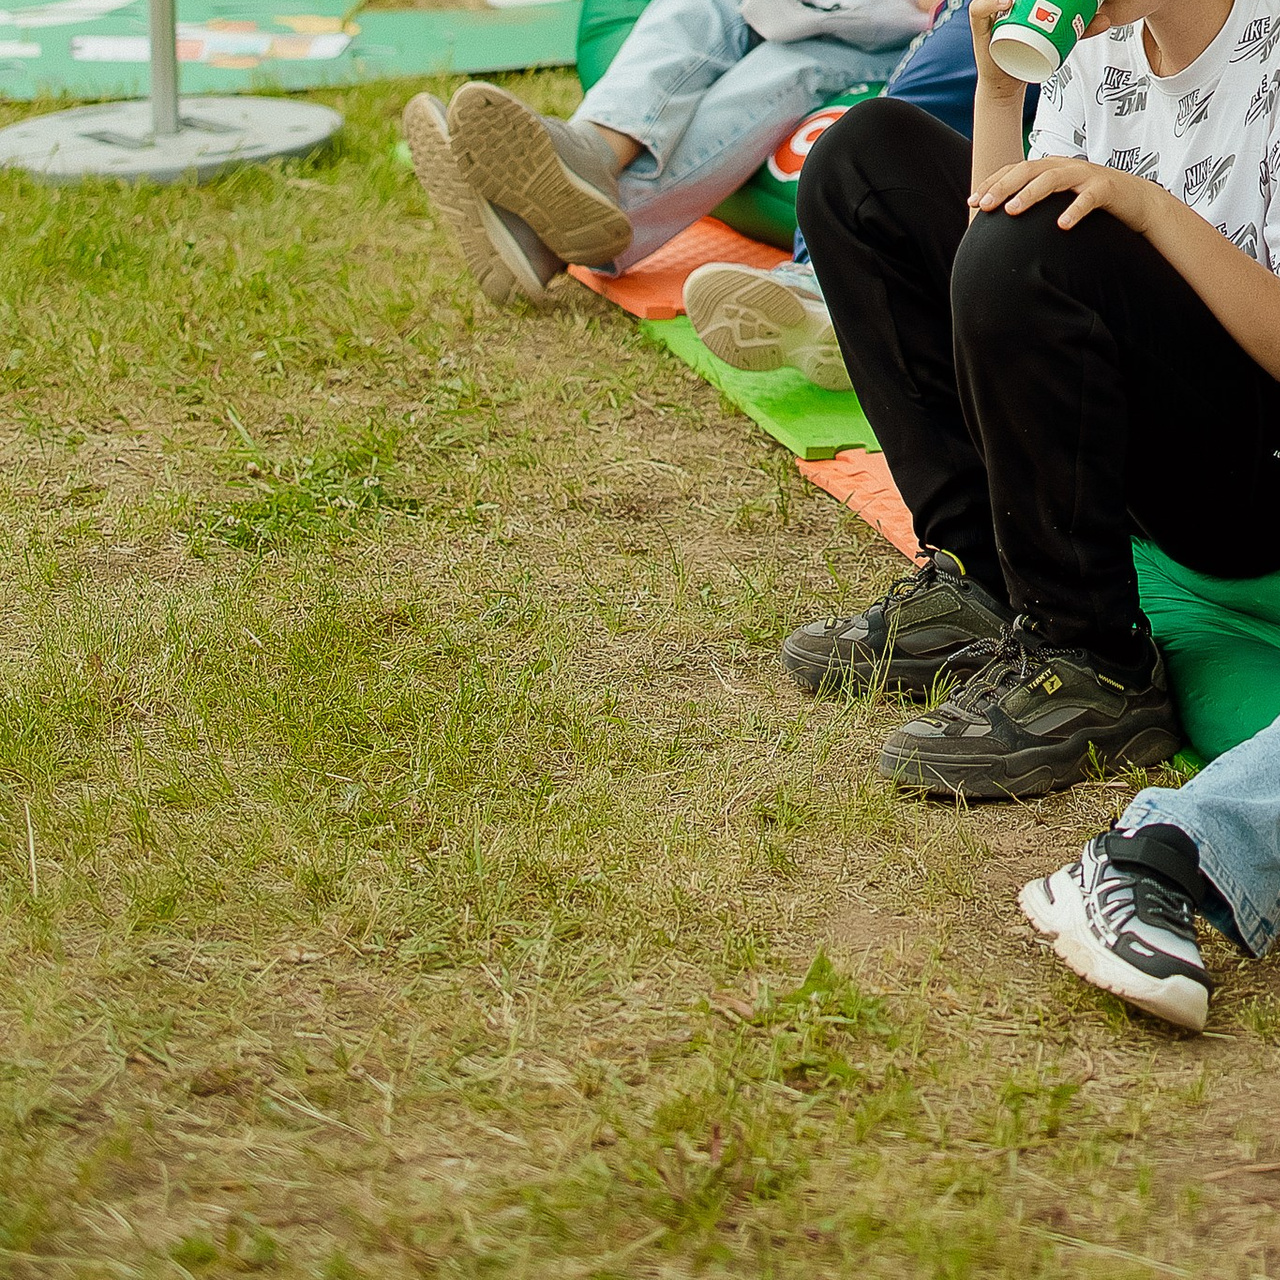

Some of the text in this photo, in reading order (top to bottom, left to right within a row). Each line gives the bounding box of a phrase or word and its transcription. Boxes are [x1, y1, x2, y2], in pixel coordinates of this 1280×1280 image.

[1237, 16, 1271, 45] IKE
[1103, 65, 1132, 89] IKE
[1109, 146, 1141, 173] NIKE
[1185, 155, 1213, 190] NIKE
